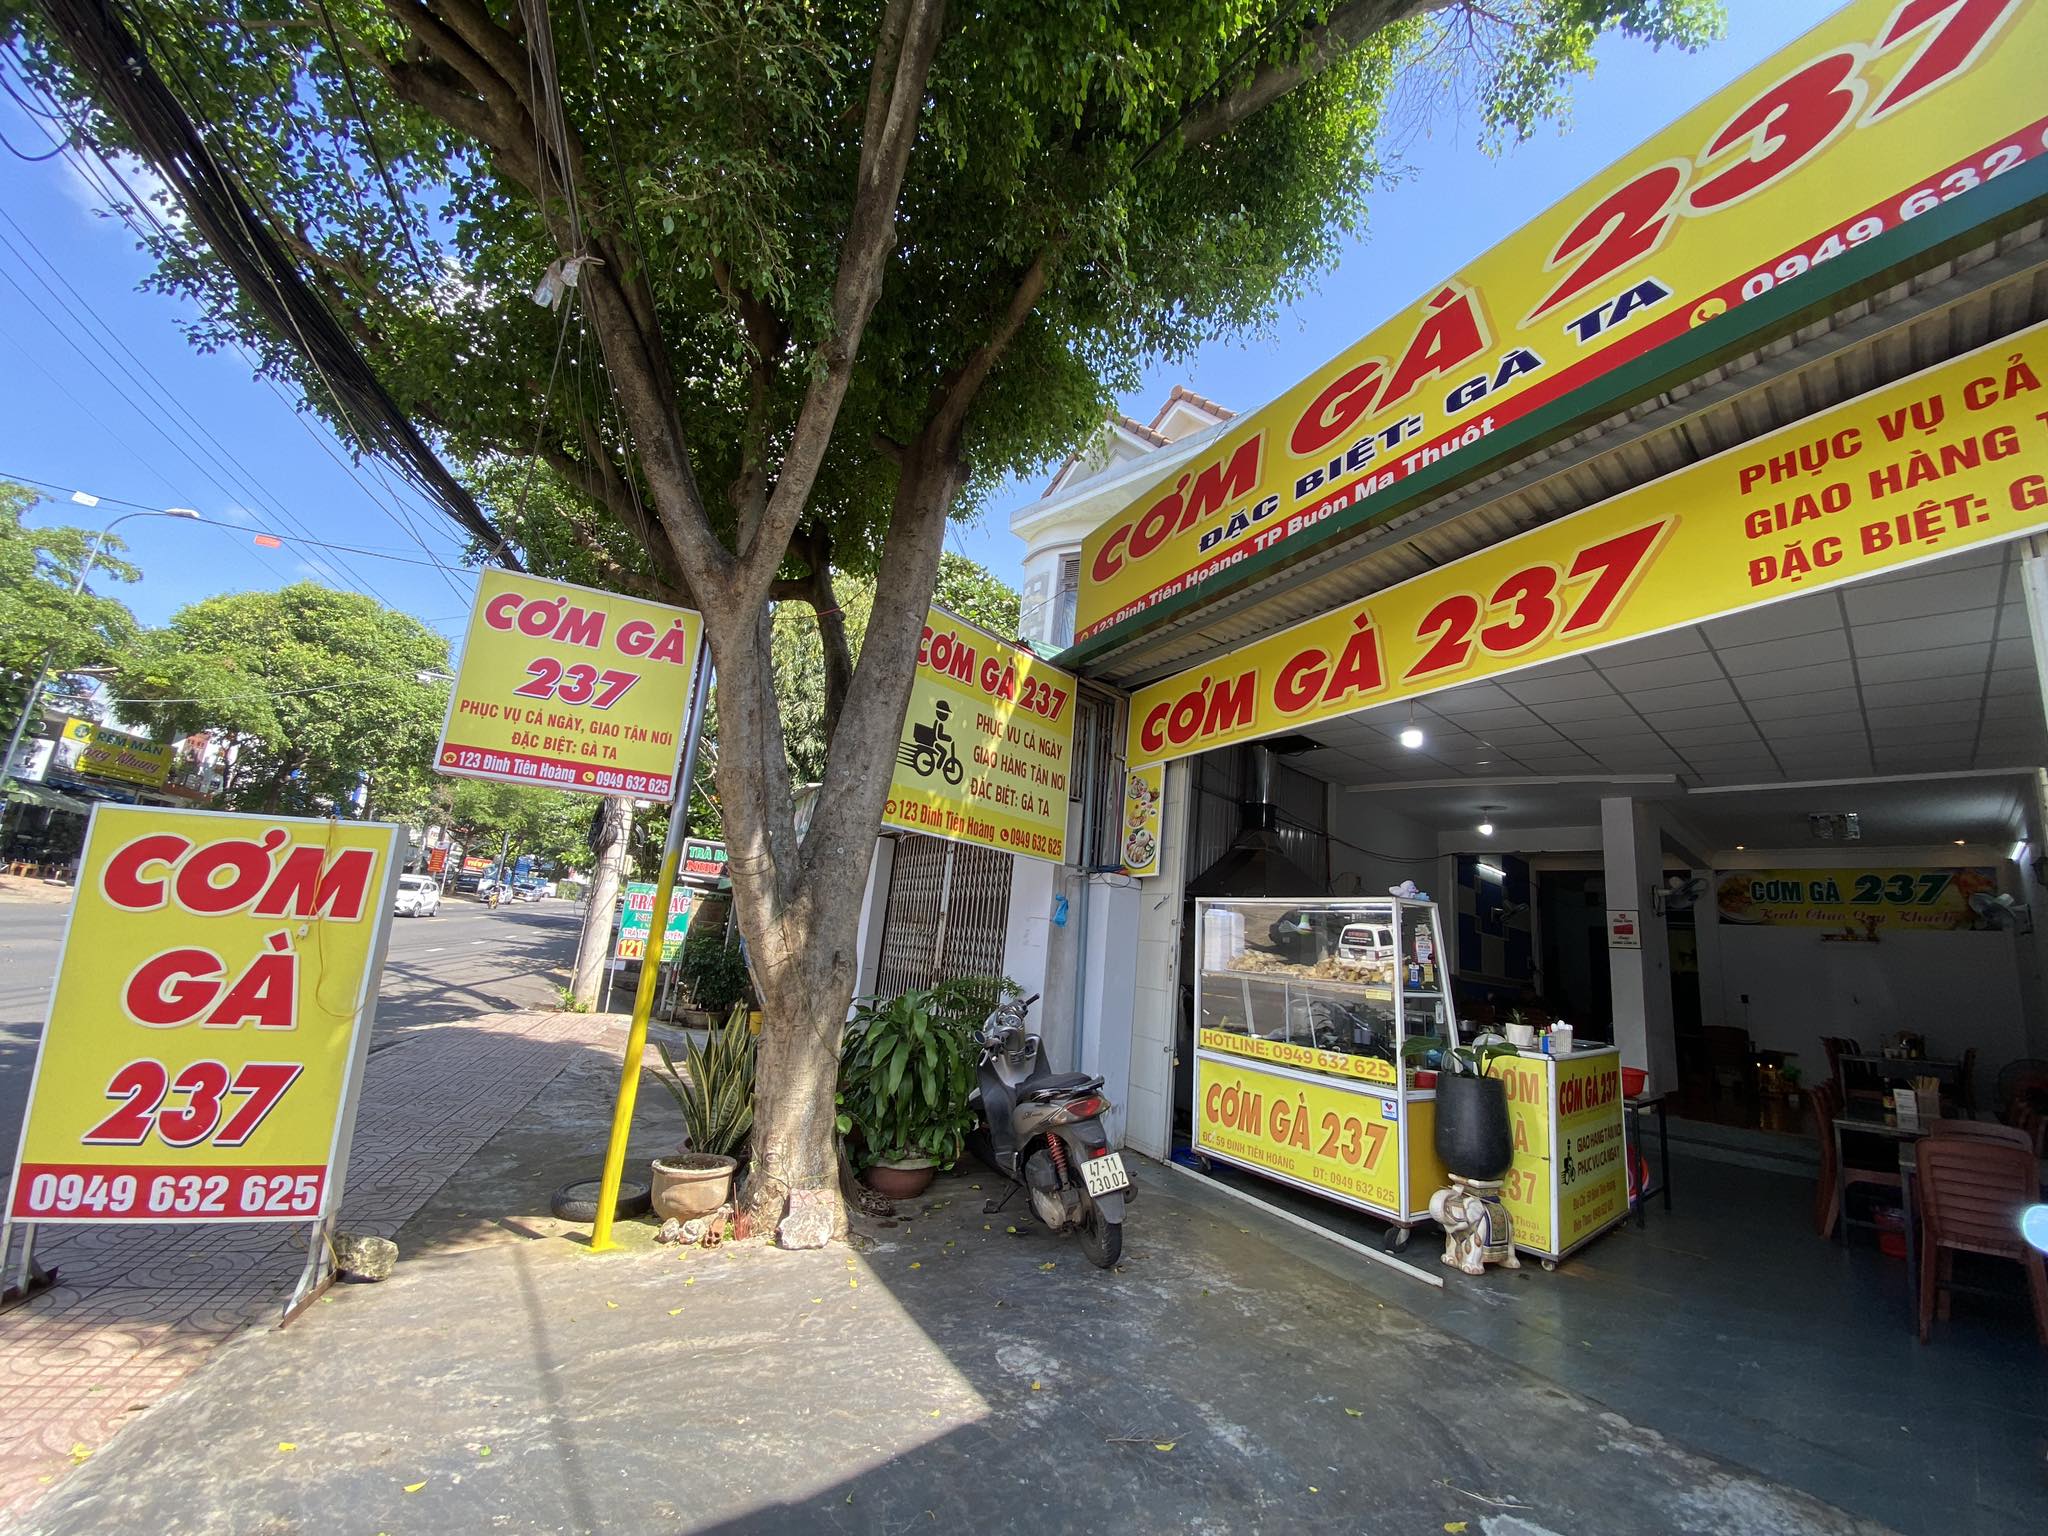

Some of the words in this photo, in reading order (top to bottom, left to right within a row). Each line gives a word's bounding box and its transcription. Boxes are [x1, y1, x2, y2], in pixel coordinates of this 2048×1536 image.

[1091, 430, 1264, 583] CƠM
[1290, 284, 1485, 456] GÀ
[1522, 0, 2014, 324] 237
[1093, 618, 1113, 635] 123
[1149, 582, 1181, 606] Tiên
[1254, 527, 1282, 552] TP
[1287, 495, 1348, 537] Buôn
[1355, 471, 1395, 502] Ma
[1741, 216, 1883, 301] 0949
[1899, 145, 2026, 222] 632
[1199, 494, 1279, 554] ĐẶC
[1295, 414, 1423, 499] BIỆT:
[1445, 347, 1544, 415] GÀ
[1567, 277, 1673, 344] TA
[1738, 428, 1863, 496] PHỤC
[1877, 394, 1945, 436] VỤ
[1963, 353, 2041, 412] CẢ
[1744, 482, 1852, 540] GIAO
[1868, 425, 2021, 500] HÀNG
[1748, 536, 1843, 587] ĐẶC
[1860, 493, 1990, 555] BIỆT:
[485, 593, 606, 649] CƠM
[615, 618, 686, 666] GÀ
[1140, 670, 1258, 754] CƠM
[1274, 611, 1383, 712] GÀ
[1404, 519, 1670, 680] 237
[513, 657, 641, 711] 237
[917, 626, 976, 686] CƠM
[980, 656, 1016, 704] GÀ
[1017, 676, 1068, 720] 237
[460, 700, 498, 718] PHỤC
[503, 706, 520, 722] VỤ
[526, 708, 545, 725] CẢ
[547, 714, 584, 733] NGÀY,
[590, 721, 619, 738] GIAO
[624, 725, 647, 743] TẬN
[651, 730, 672, 746] NƠI
[512, 732, 538, 750] ĐẶC
[543, 736, 576, 755] BIỆT:
[581, 740, 597, 757] GÀ
[602, 745, 617, 760] TA
[976, 712, 1005, 739] PHỤC
[1007, 727, 1020, 745] VỤ
[1023, 729, 1037, 751] CẢ
[1039, 736, 1062, 761] NGÀY
[459, 752, 480, 768] 123
[514, 758, 538, 775] Tiên
[540, 762, 576, 782] Hoàng
[596, 771, 623, 789] 0949
[626, 775, 646, 791] 632
[648, 778, 668, 794] 625
[973, 745, 998, 769] GIAO
[1001, 752, 1027, 779] HÀNG
[1031, 764, 1050, 788] TẬN
[1051, 773, 1066, 792] NƠI
[970, 778, 992, 802] ĐẶC
[995, 784, 1018, 810] BIỆT:
[1021, 792, 1034, 811] GÀ
[1037, 799, 1050, 817] TA
[899, 800, 918, 822] 123
[945, 809, 965, 832] Tiên
[967, 816, 995, 842] Hoàng
[1010, 829, 1031, 850] 0949
[1032, 834, 1047, 853] 632
[1048, 838, 1062, 857] 625
[102, 828, 376, 920] CƠM
[1751, 878, 1803, 904] CƠM
[1809, 877, 1841, 904] GÀ
[1851, 873, 1952, 906] 237
[619, 939, 644, 957] 121
[124, 930, 298, 1029] GÀ
[1203, 1032, 1269, 1056] HOTLINE:
[1273, 1045, 1313, 1065] 0949
[1317, 1054, 1350, 1072] 632
[1354, 1060, 1390, 1079] 625
[81, 1059, 304, 1148] 237
[1559, 1073, 1583, 1116] CƠM
[1584, 1067, 1599, 1107] GÀ
[1600, 1071, 1618, 1103] 237
[1206, 1080, 1262, 1136] CƠM
[1269, 1092, 1311, 1151] GÀ
[1317, 1112, 1388, 1170] 237
[29, 1173, 137, 1212] 0949
[148, 1175, 228, 1212] 632
[239, 1175, 319, 1211] 625
[1089, 1171, 1128, 1195] 230.02
[1215, 1135, 1226, 1148] 59
[1247, 1143, 1265, 1161] TIÊN
[1313, 1167, 1328, 1181] ĐT:
[1330, 1172, 1353, 1189] 0949
[1355, 1178, 1373, 1196] 632
[1376, 1184, 1395, 1202] 625
[1499, 1169, 1537, 1206] 37
